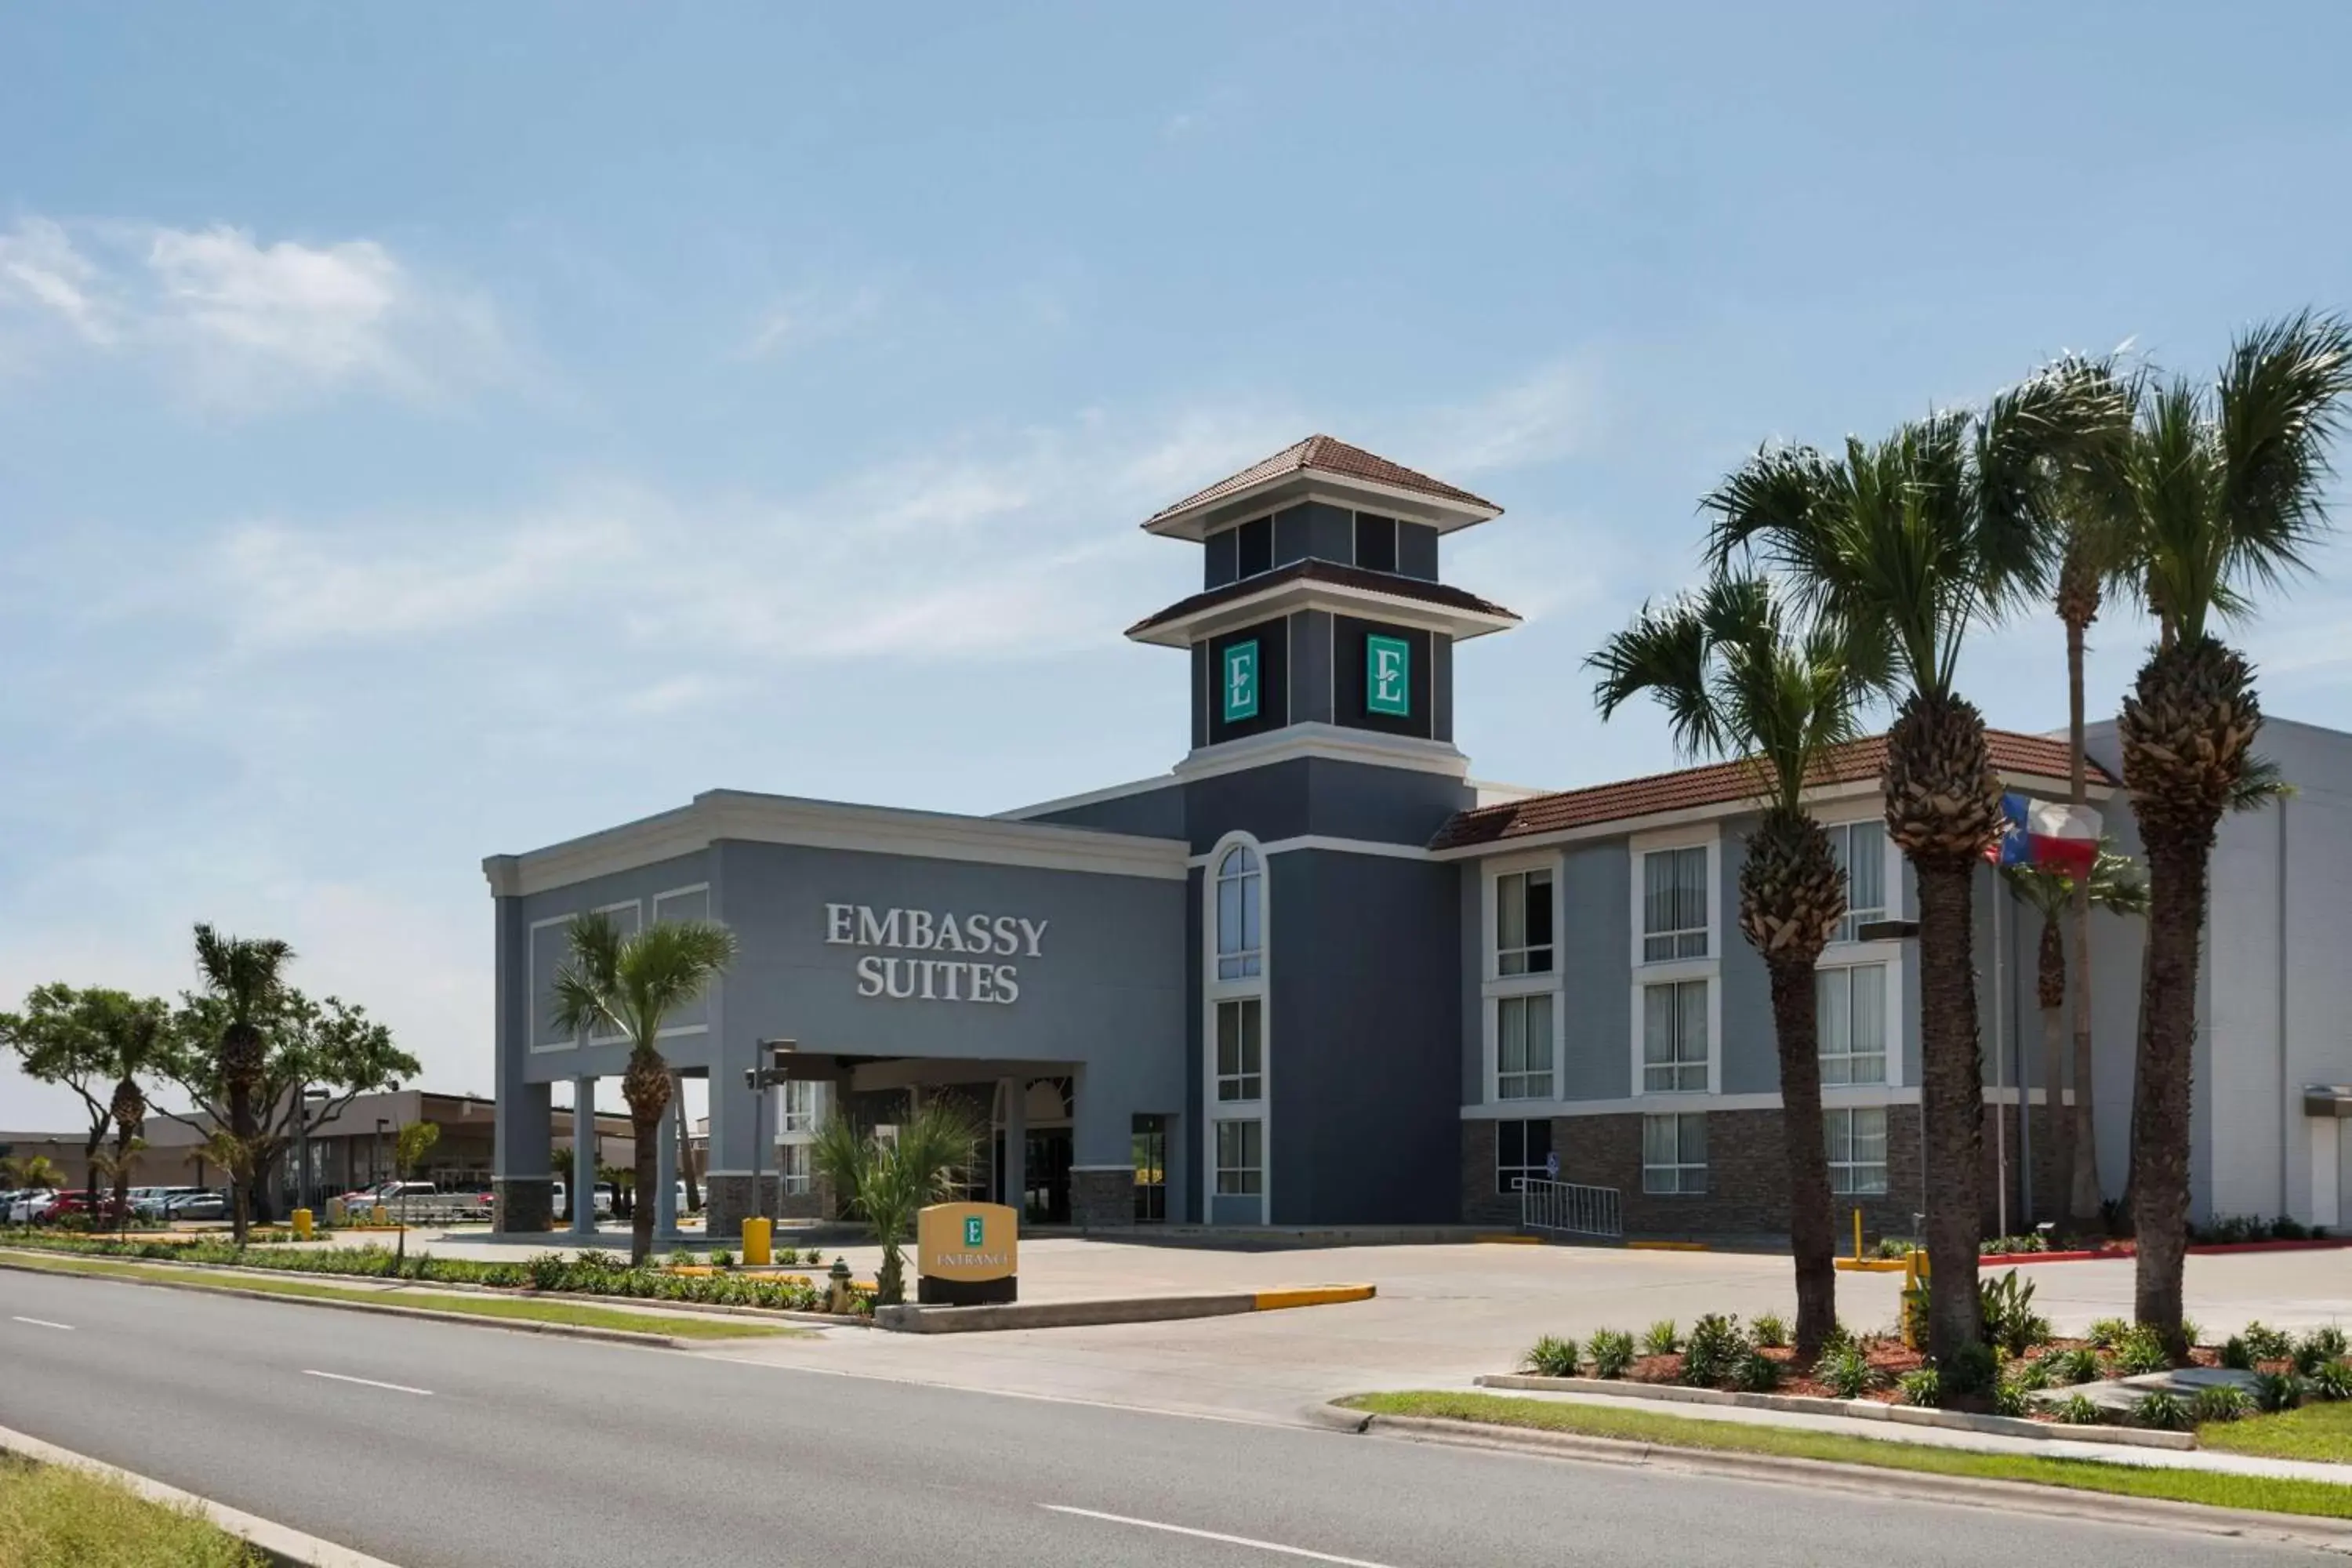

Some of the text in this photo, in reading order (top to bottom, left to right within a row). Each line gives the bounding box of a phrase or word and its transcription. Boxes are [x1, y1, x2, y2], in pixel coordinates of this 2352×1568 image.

[1230, 654, 1250, 708] E
[1376, 648, 1401, 702] E
[825, 902, 1049, 958] EMBASSY
[857, 955, 1019, 1004] SUITES
